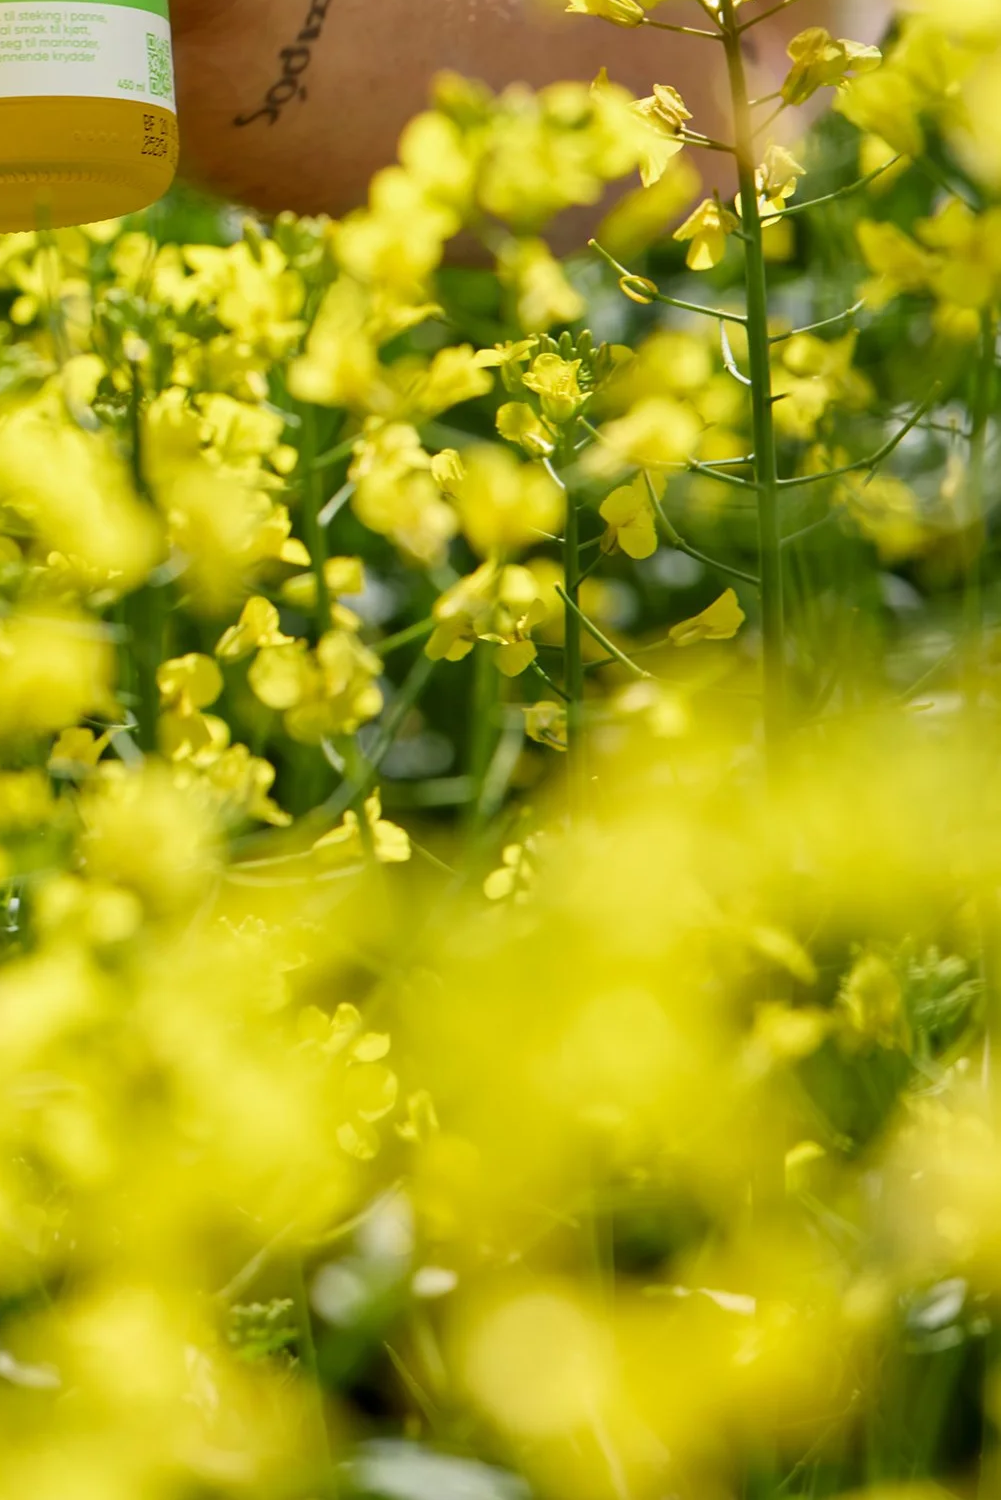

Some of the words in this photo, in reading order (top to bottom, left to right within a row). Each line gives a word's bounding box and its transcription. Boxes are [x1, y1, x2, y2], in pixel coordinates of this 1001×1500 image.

[4, 11, 15, 21] til
[18, 10, 61, 24] steking
[70, 12, 108, 24] panne,
[14, 24, 47, 35] smak
[50, 22, 60, 33] til
[0, 39, 22, 51] seg
[25, 37, 36, 48] til
[52, 51, 96, 64] krydder
